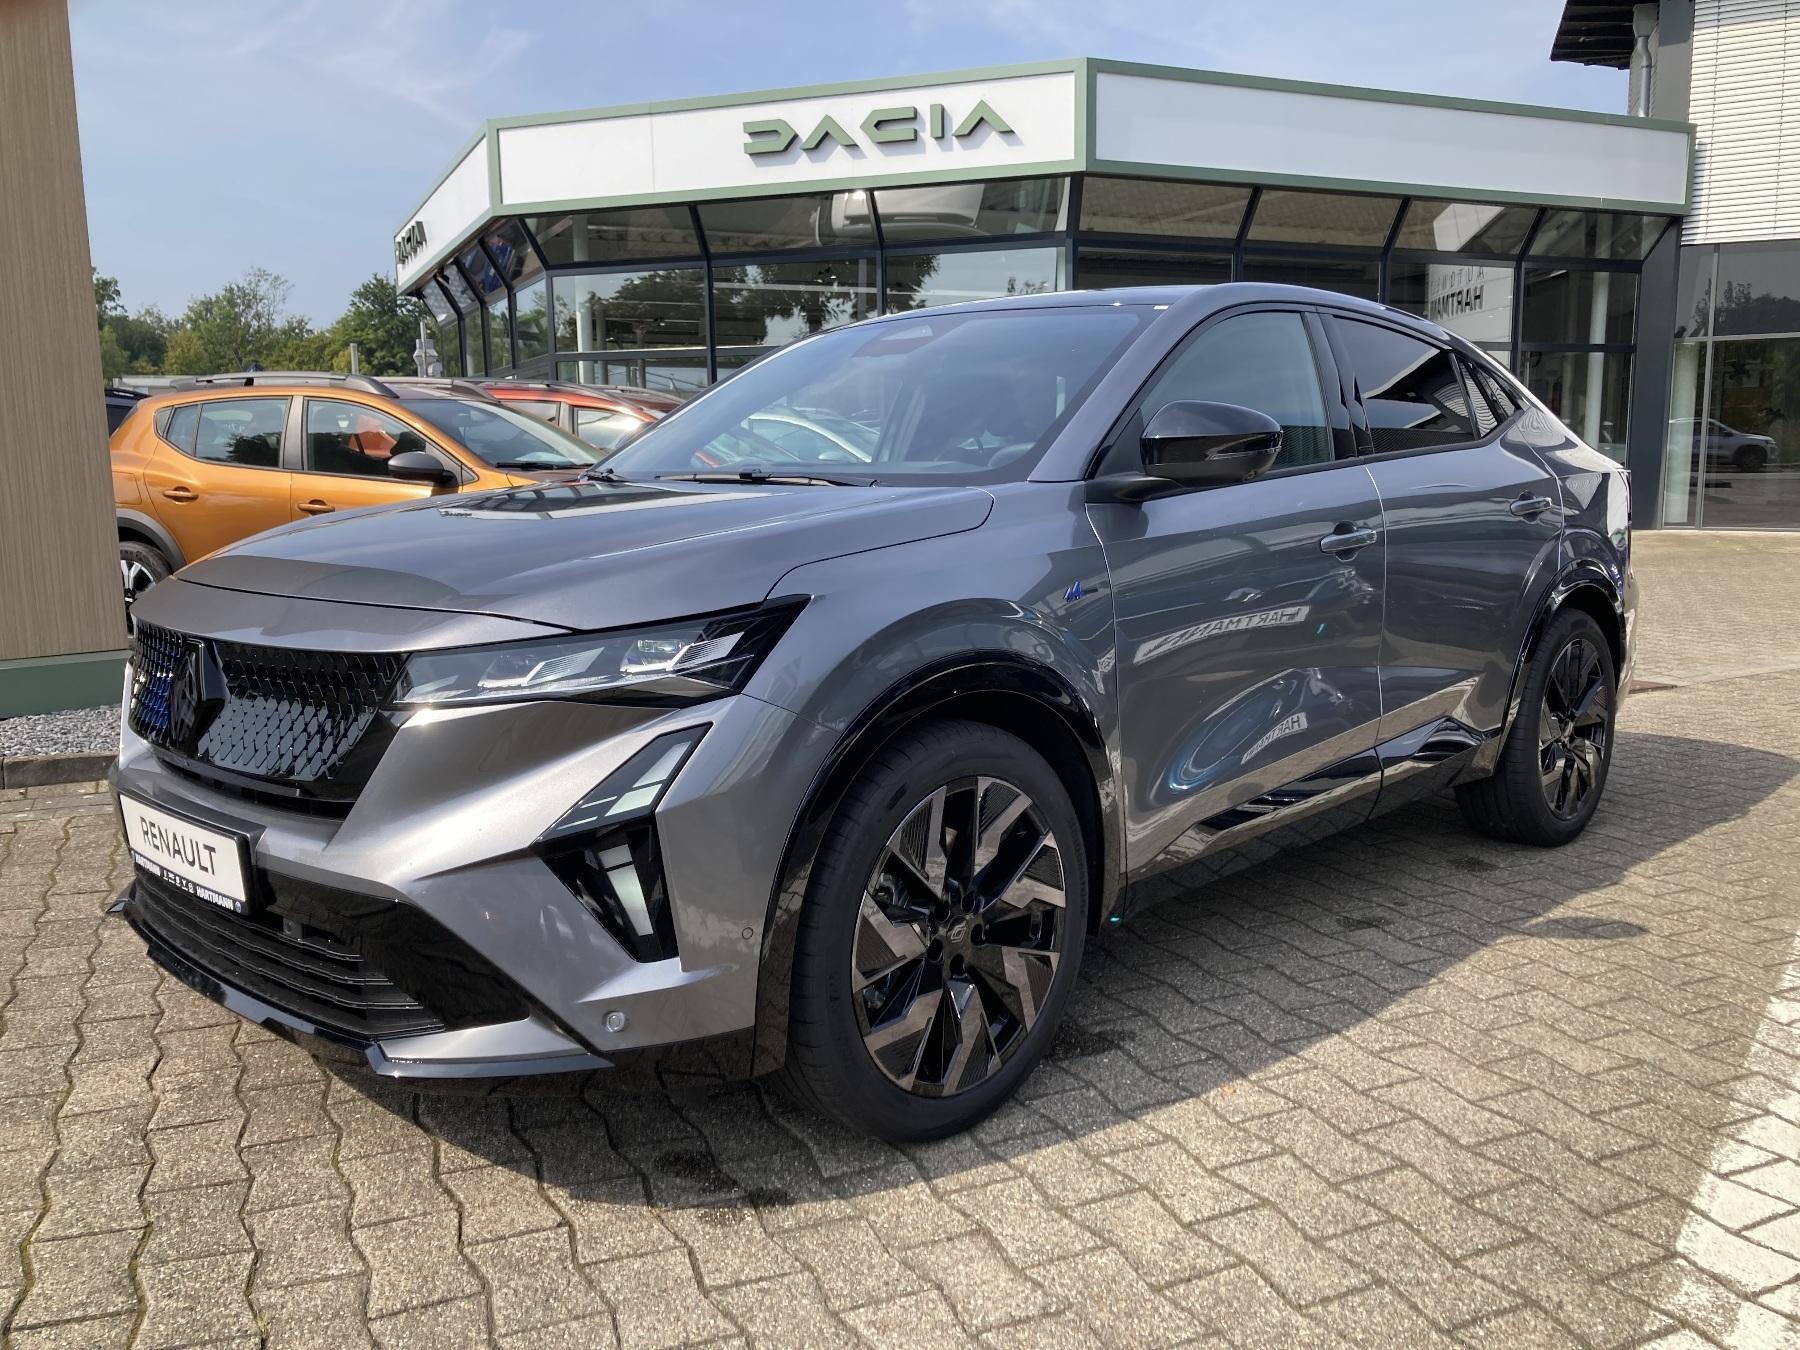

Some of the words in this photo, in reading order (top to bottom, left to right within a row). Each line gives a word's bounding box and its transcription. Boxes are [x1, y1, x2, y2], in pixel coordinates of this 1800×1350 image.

[743, 99, 1015, 154] DACIA
[140, 816, 217, 876] RENAULT
[196, 886, 234, 911] HARTMANN
